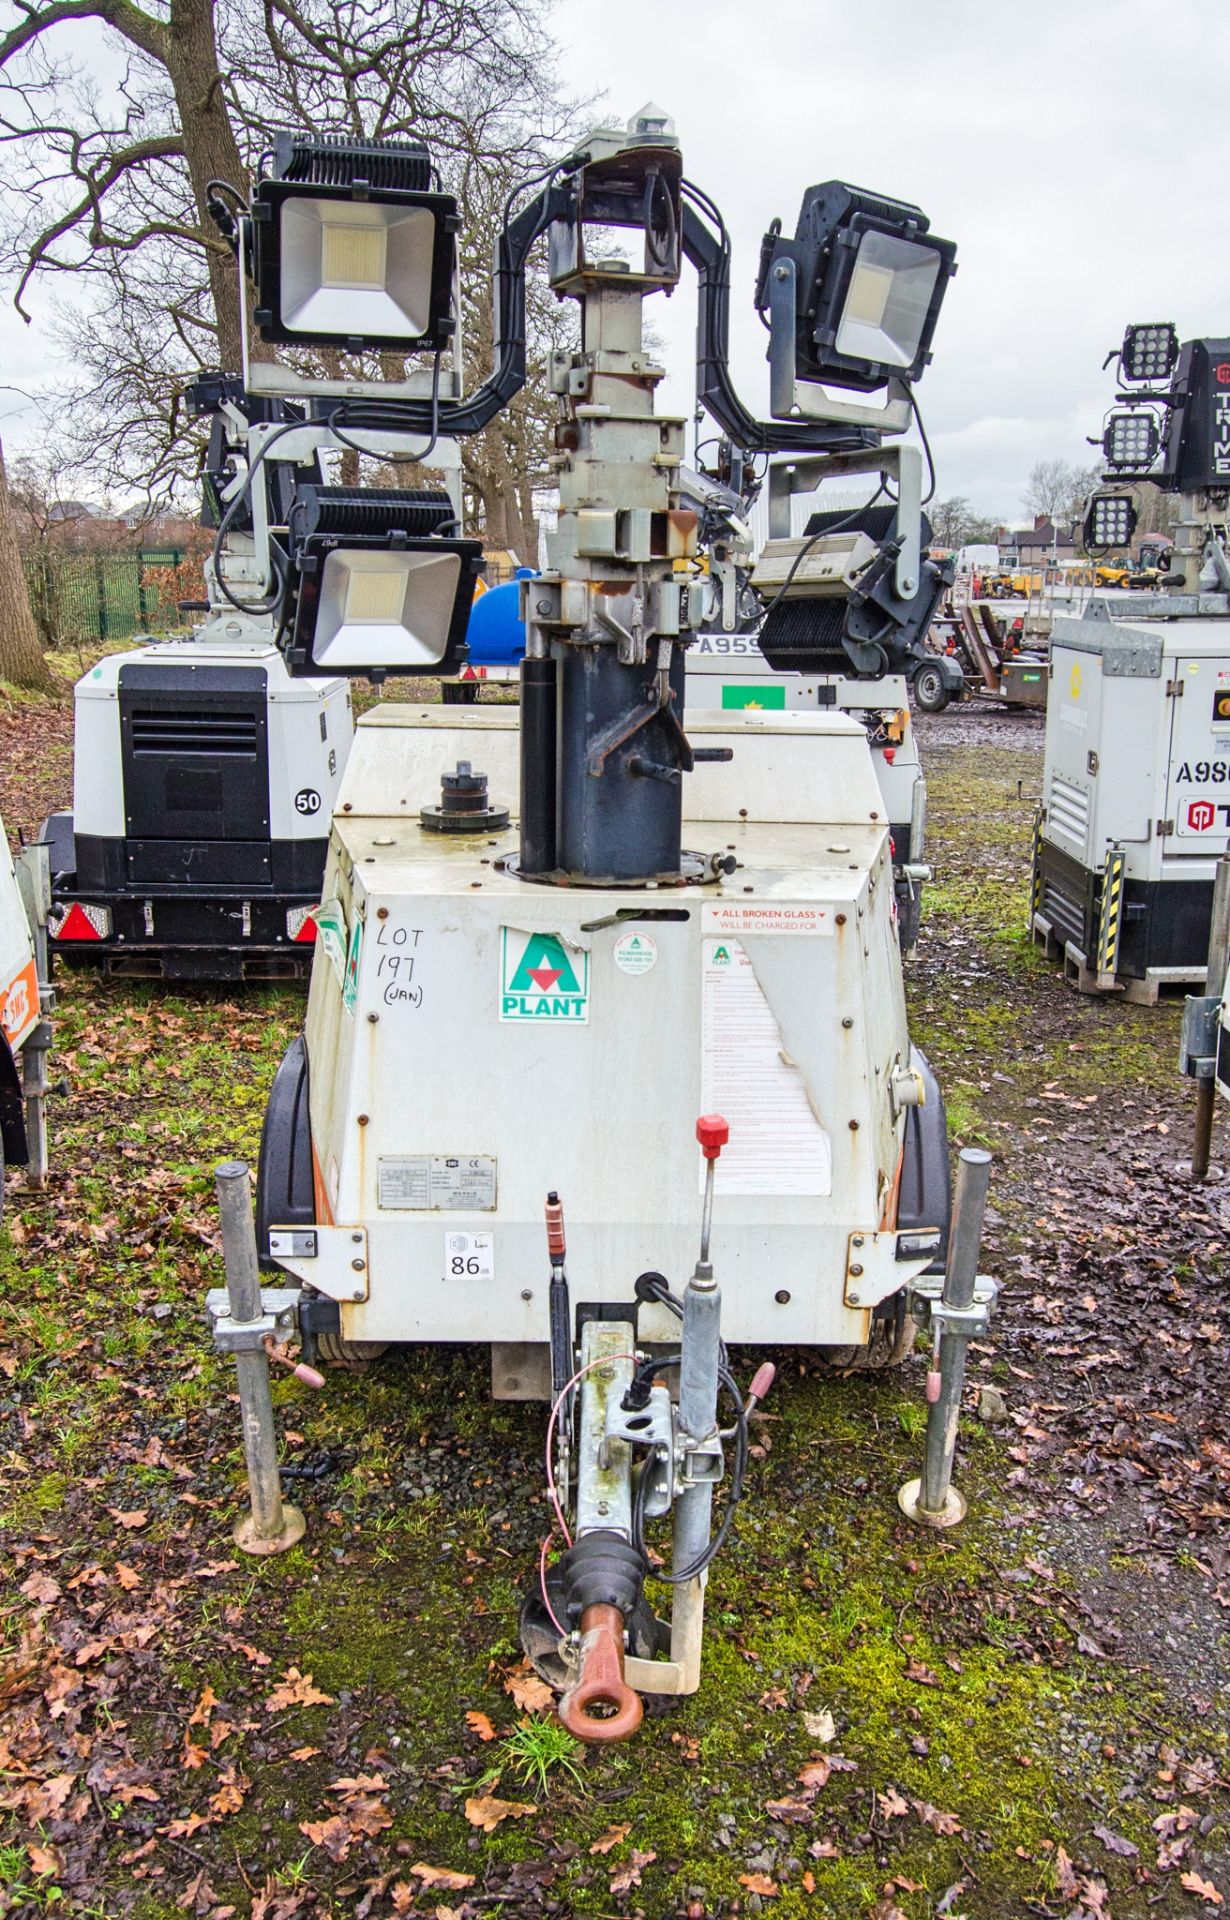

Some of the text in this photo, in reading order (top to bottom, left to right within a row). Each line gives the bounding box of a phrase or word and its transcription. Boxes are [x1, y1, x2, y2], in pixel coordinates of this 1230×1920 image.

[417, 340, 433, 348] IP67
[1176, 762, 1230, 783] A98
[297, 794, 320, 811] 50
[722, 910, 740, 918] ALL
[742, 910, 781, 918] BROKEN
[720, 921, 741, 929] WILL
[755, 922, 798, 930] CHARGED
[377, 924, 424, 947] LOT
[377, 954, 414, 982] 197
[384, 981, 423, 1008] (JAN)
[502, 997, 586, 1016] PLANT
[451, 1256, 479, 1275] 86
